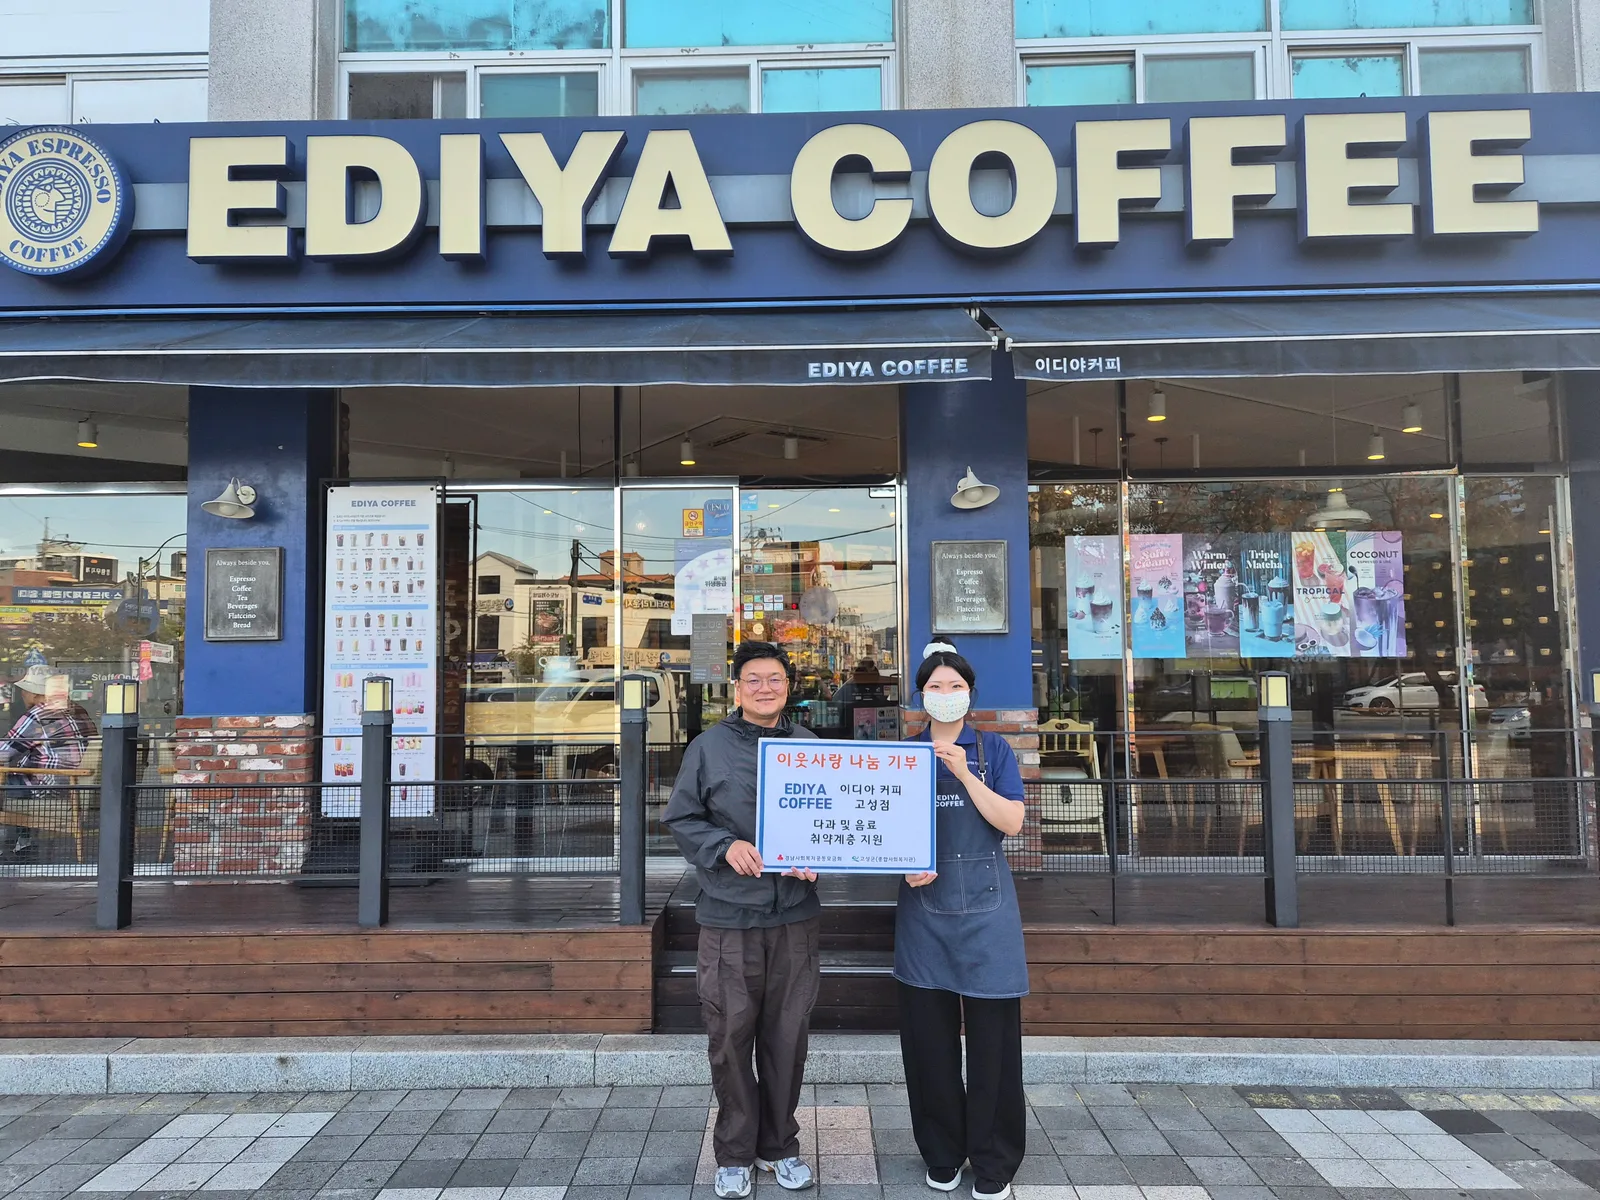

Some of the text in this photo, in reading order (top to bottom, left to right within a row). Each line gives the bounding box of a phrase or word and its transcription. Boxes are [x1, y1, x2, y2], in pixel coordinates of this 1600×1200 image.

[26, 138, 111, 204] ESPRESSO
[187, 108, 1539, 258] EDIYA COFFEE
[9, 236, 88, 263] COFFEE
[808, 358, 968, 378] EDIYA COFFEE
[1035, 356, 1121, 373] 이디야커피
[381, 499, 416, 507] COFFEE
[1192, 551, 1226, 560] Warm
[1248, 549, 1279, 562] Triple
[1350, 551, 1398, 559] COCONUT
[1133, 557, 1175, 569] Creamy
[1191, 560, 1227, 570] Winter
[1246, 560, 1283, 569] Matcha
[956, 569, 983, 577] Espresso
[229, 576, 257, 584] Espresso
[1296, 587, 1345, 595] TROPICAL
[955, 596, 986, 604] Beverages
[91, 673, 115, 681] Staff
[777, 752, 918, 771] 이웃사랑 나눔 기부
[784, 783, 827, 795] EDIYA
[839, 784, 902, 796] 이디아 커피
[778, 797, 832, 810] COFFEE
[854, 799, 890, 812] 고성점
[813, 819, 877, 831] 다과 및 음료
[810, 833, 883, 846] 취약계층 지원
